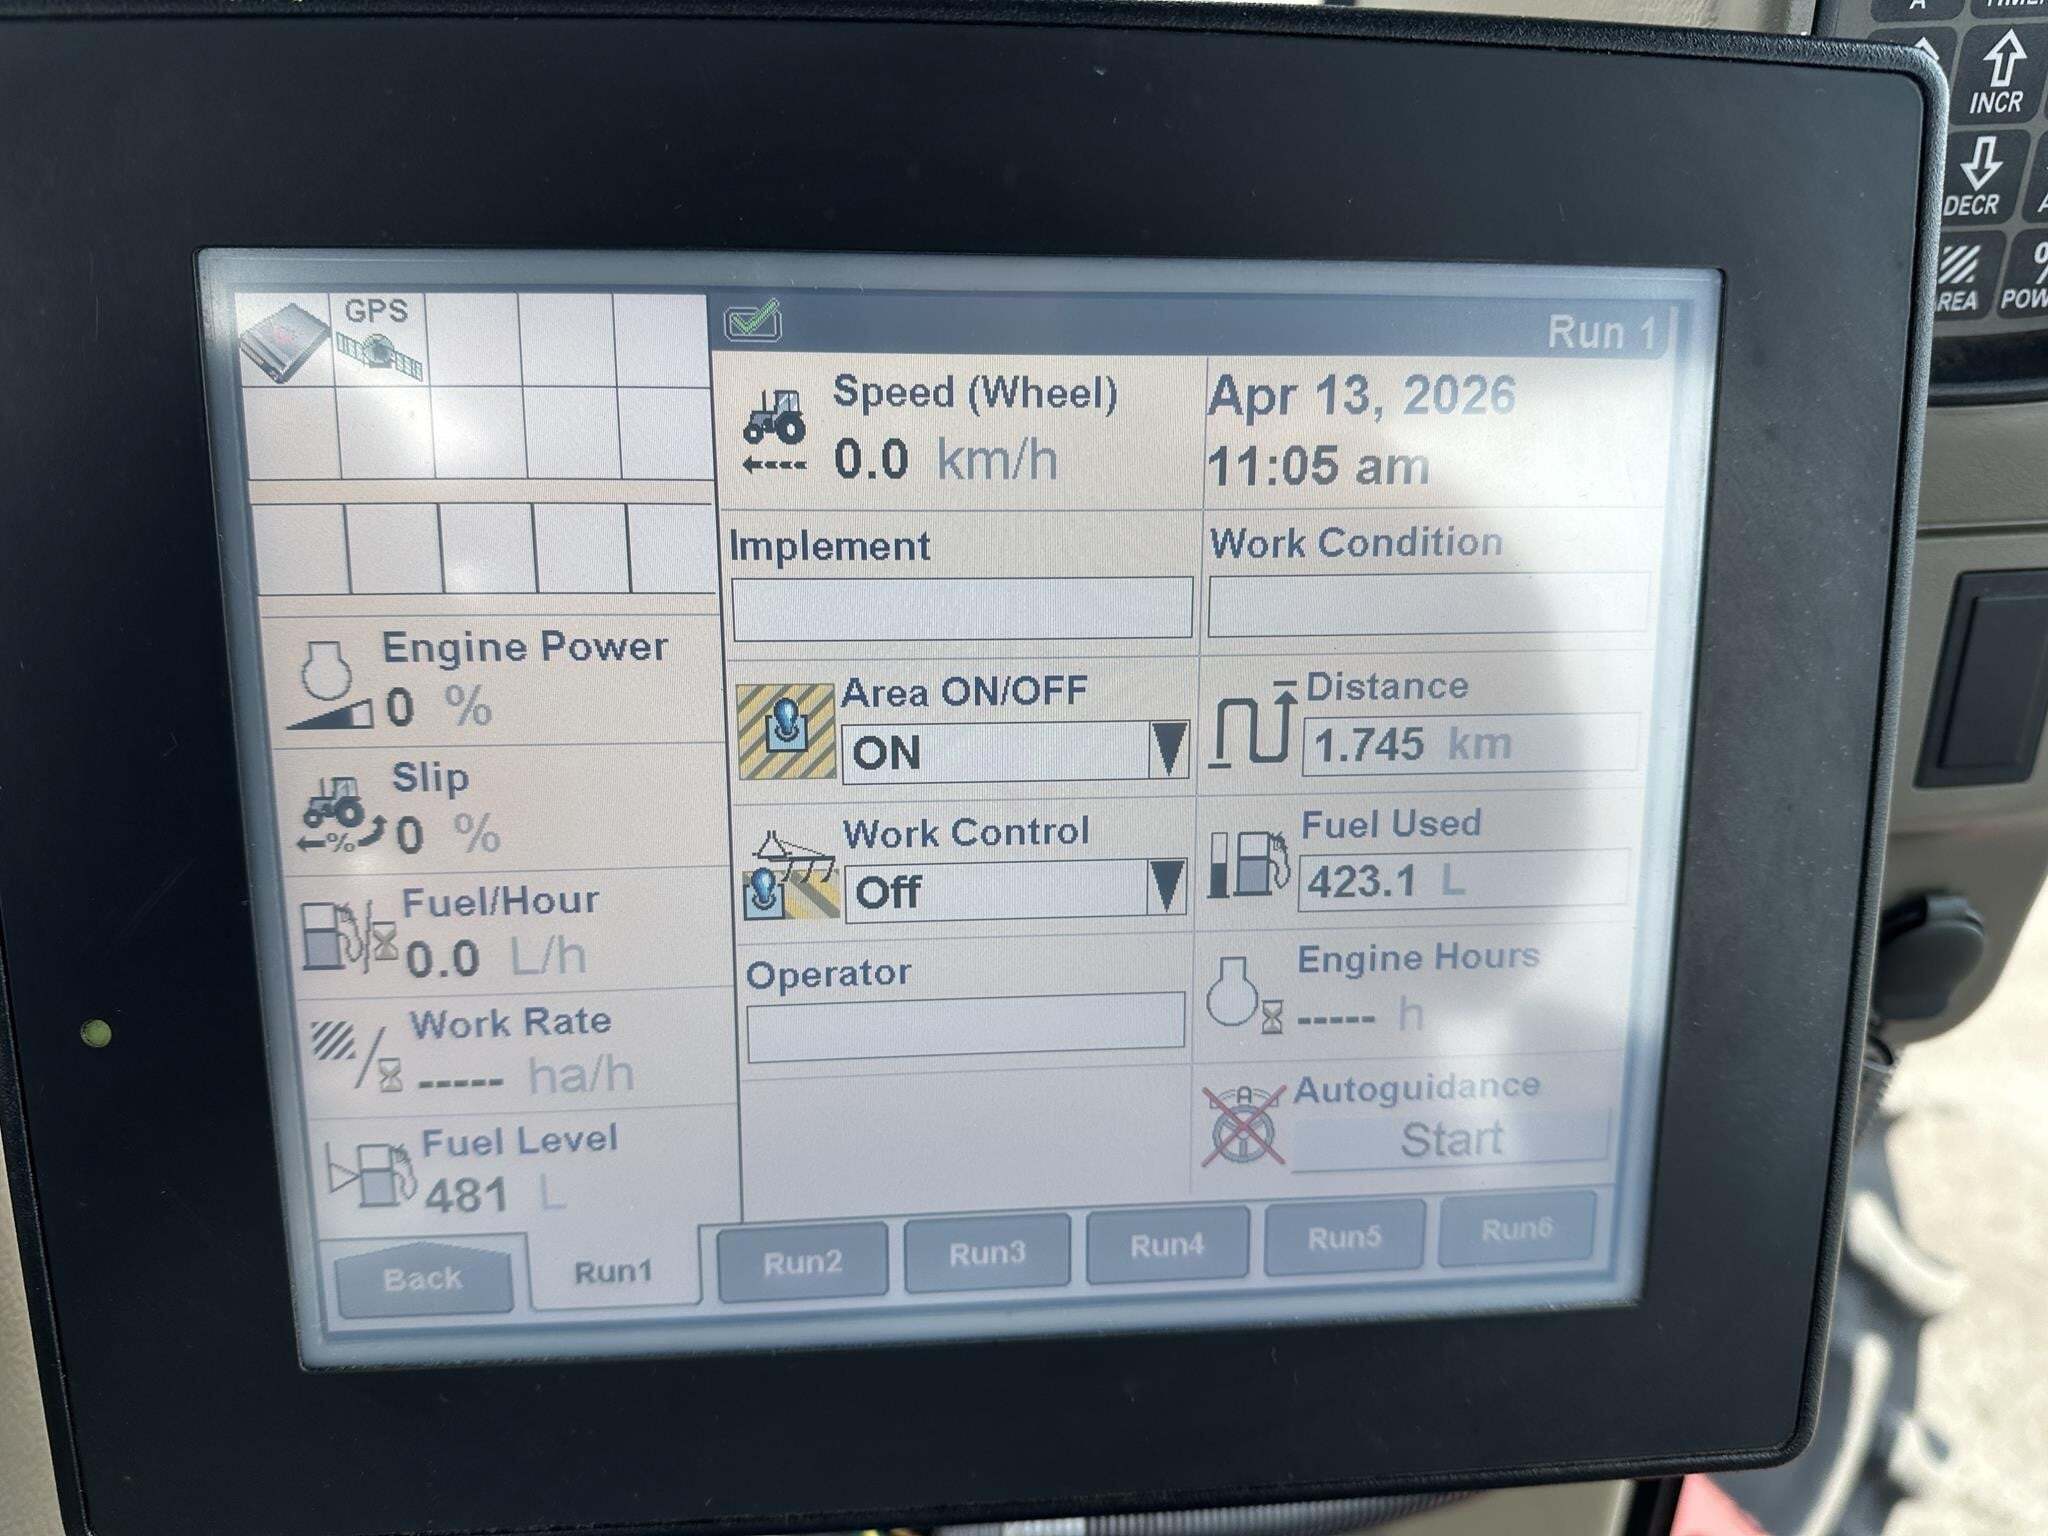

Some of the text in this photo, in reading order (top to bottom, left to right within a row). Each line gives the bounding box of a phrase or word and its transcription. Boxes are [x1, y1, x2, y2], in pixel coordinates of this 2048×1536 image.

[1970, 91, 2023, 114] INCR
[1943, 194, 2000, 216] DECR
[345, 298, 408, 323] GPS
[1936, 290, 1978, 311] REA
[2001, 288, 2048, 309] POW
[1548, 313, 1655, 349] Run 1
[833, 373, 1118, 417] Speed (Wheel)
[1207, 373, 1517, 425] Apr 13, 2026
[835, 436, 1058, 480] 0.0 km/h
[1207, 444, 1430, 486] 11:05 am
[731, 528, 931, 569] Implement
[1211, 526, 1504, 559] Work Condition
[383, 629, 669, 671] Engine Power
[841, 674, 1089, 708] Area ON/OFF
[1307, 670, 1469, 701] Distance
[386, 684, 493, 727] 0 %
[853, 735, 921, 770] ON
[1315, 725, 1512, 762] 1.745 km
[393, 761, 469, 800] Slip
[397, 813, 500, 854] 0 %
[844, 815, 1090, 849] Work Control
[1302, 807, 1482, 839] Fuel Used
[856, 875, 923, 909] Off
[1307, 862, 1467, 899] 423.1 L
[403, 886, 600, 918] Fuel/Hour
[406, 934, 587, 978] 0.0 L/h
[1298, 941, 1541, 979] Engine Hours
[746, 960, 913, 997] Operator
[410, 1006, 612, 1040] Work Rate
[1400, 994, 1424, 1031] h
[530, 1054, 634, 1094] ha/h
[1293, 1072, 1542, 1108] Autoguidance
[422, 1123, 619, 1158] Fuel Level
[1401, 1119, 1504, 1159] Start
[425, 1173, 568, 1214] 481 L
[1131, 1231, 1205, 1258] Run4
[1308, 1225, 1382, 1250] Run5
[1481, 1216, 1554, 1242] Run6
[763, 1250, 843, 1276] Run2
[950, 1240, 1027, 1267] Run3
[384, 1266, 463, 1293] Back
[574, 1259, 652, 1285] Run1
